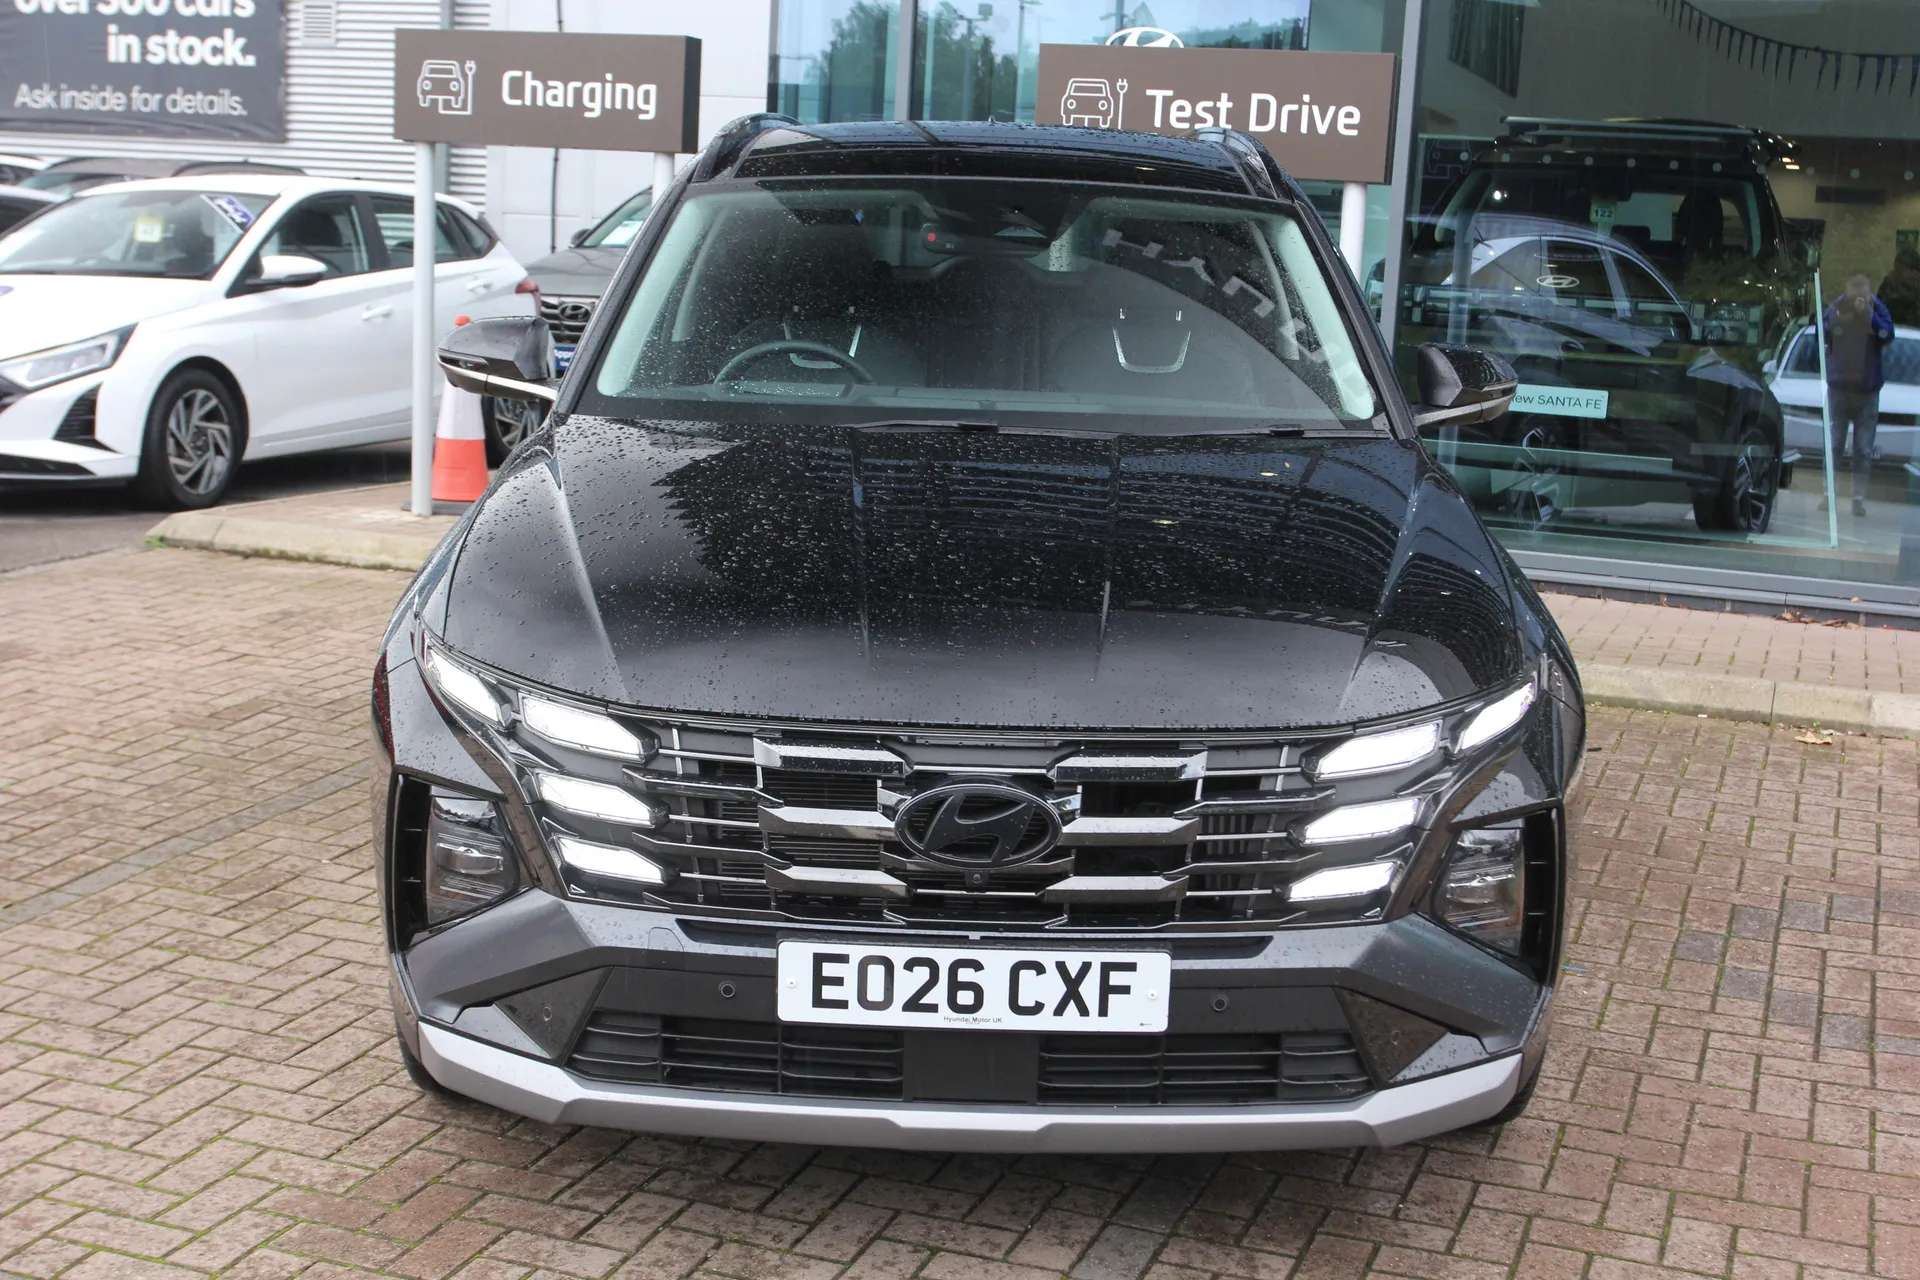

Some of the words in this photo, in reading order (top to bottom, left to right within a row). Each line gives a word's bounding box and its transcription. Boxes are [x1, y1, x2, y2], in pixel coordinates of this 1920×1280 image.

[107, 24, 141, 63] in
[146, 28, 256, 67] stock.
[14, 83, 58, 109] Ask
[60, 84, 127, 111] inside
[130, 85, 163, 113] for
[165, 87, 248, 116] details.
[502, 70, 657, 120] Charging
[1145, 89, 1233, 129] Test
[1249, 93, 1361, 136] Drive
[1512, 394, 1534, 405] ew
[1537, 394, 1582, 408] SANTA
[1585, 398, 1602, 410] FE
[1008, 960, 1138, 1017] CXF
